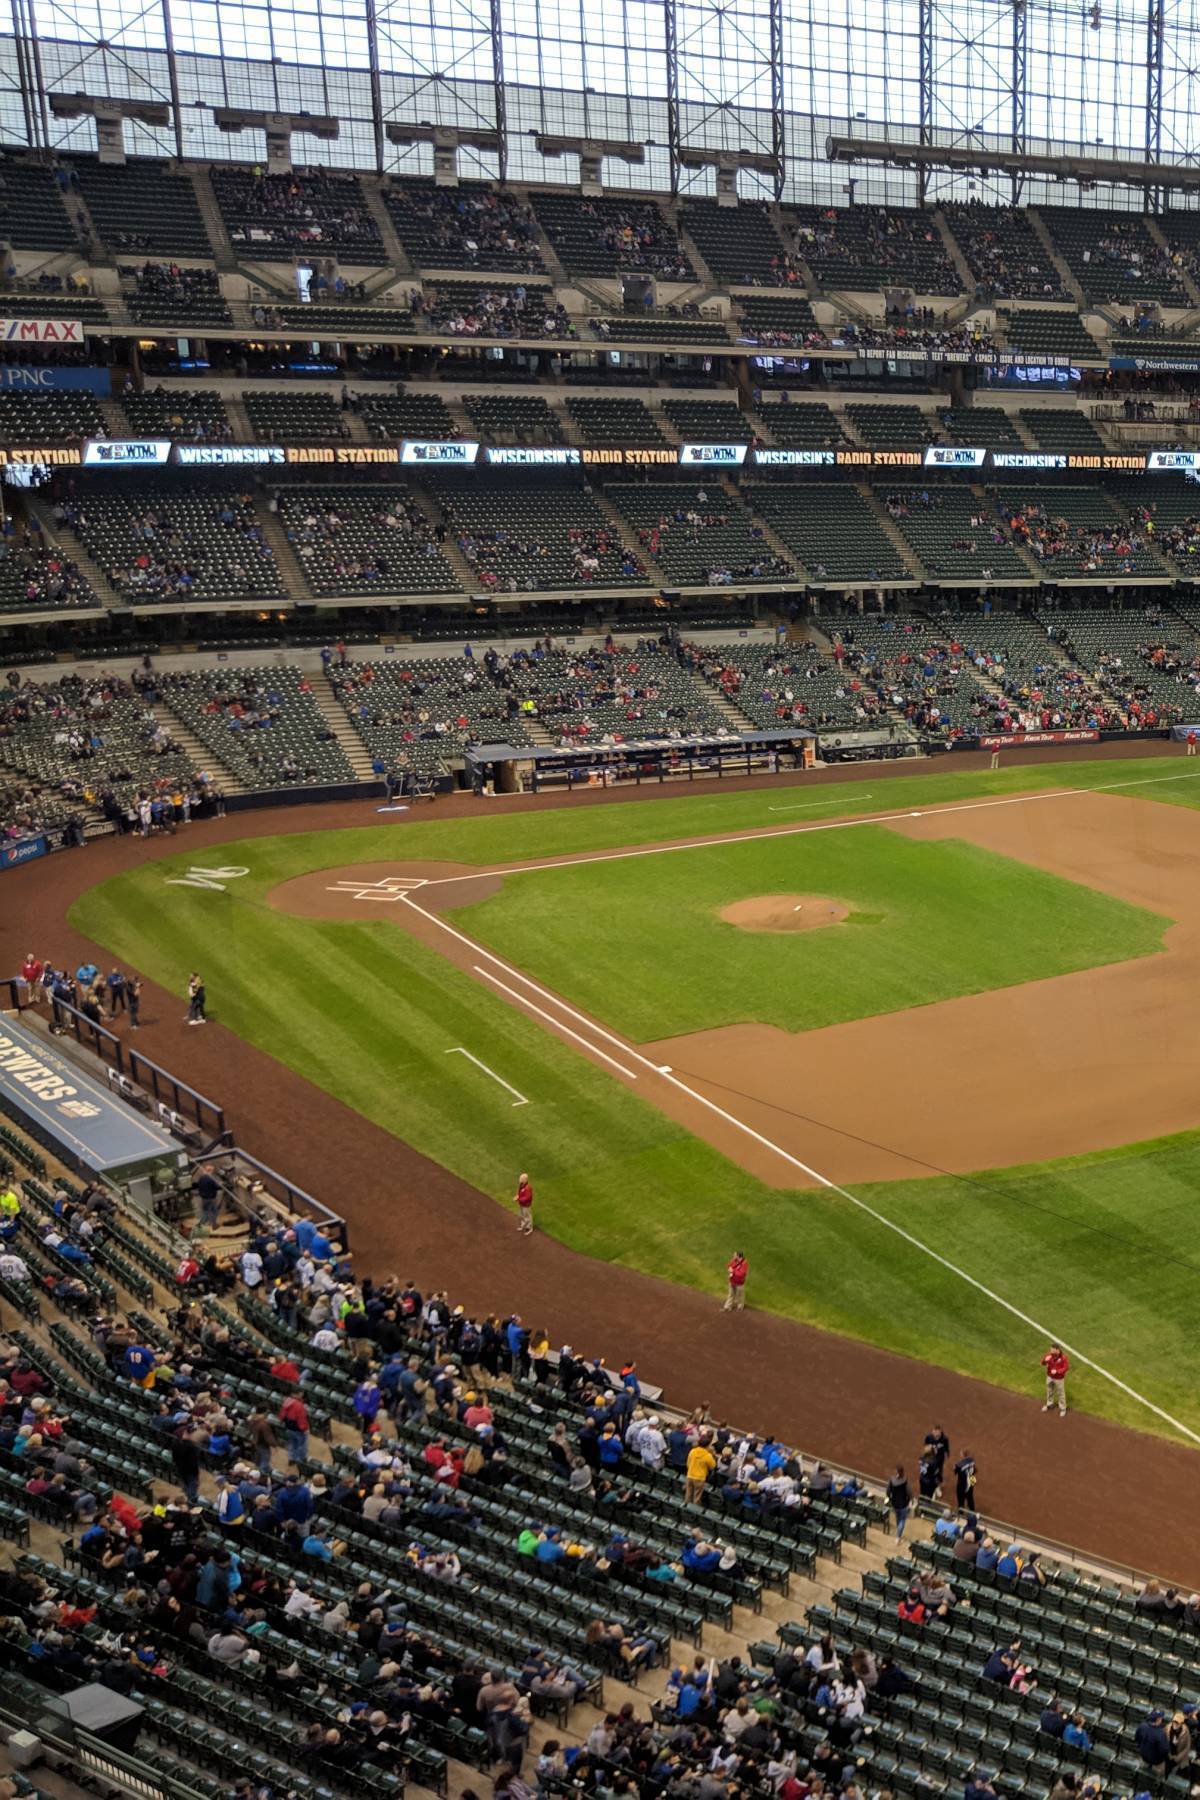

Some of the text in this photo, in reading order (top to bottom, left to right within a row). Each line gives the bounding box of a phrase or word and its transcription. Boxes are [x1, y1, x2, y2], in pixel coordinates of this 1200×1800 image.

[1146, 360, 1198, 370] Northwestern
[8, 368, 55, 386] PNC
[9, 449, 80, 464] STATION
[178, 448, 399, 464] WISCONSIN'S RADIO STATION
[487, 448, 678, 464] WISCONSIN'S RADIO STATION
[755, 450, 922, 465] WISCONSIN'S RADIO STATION
[993, 454, 1146, 468] WISCONSIN'S RADIO STATION
[18, 844, 38, 857] pepsi
